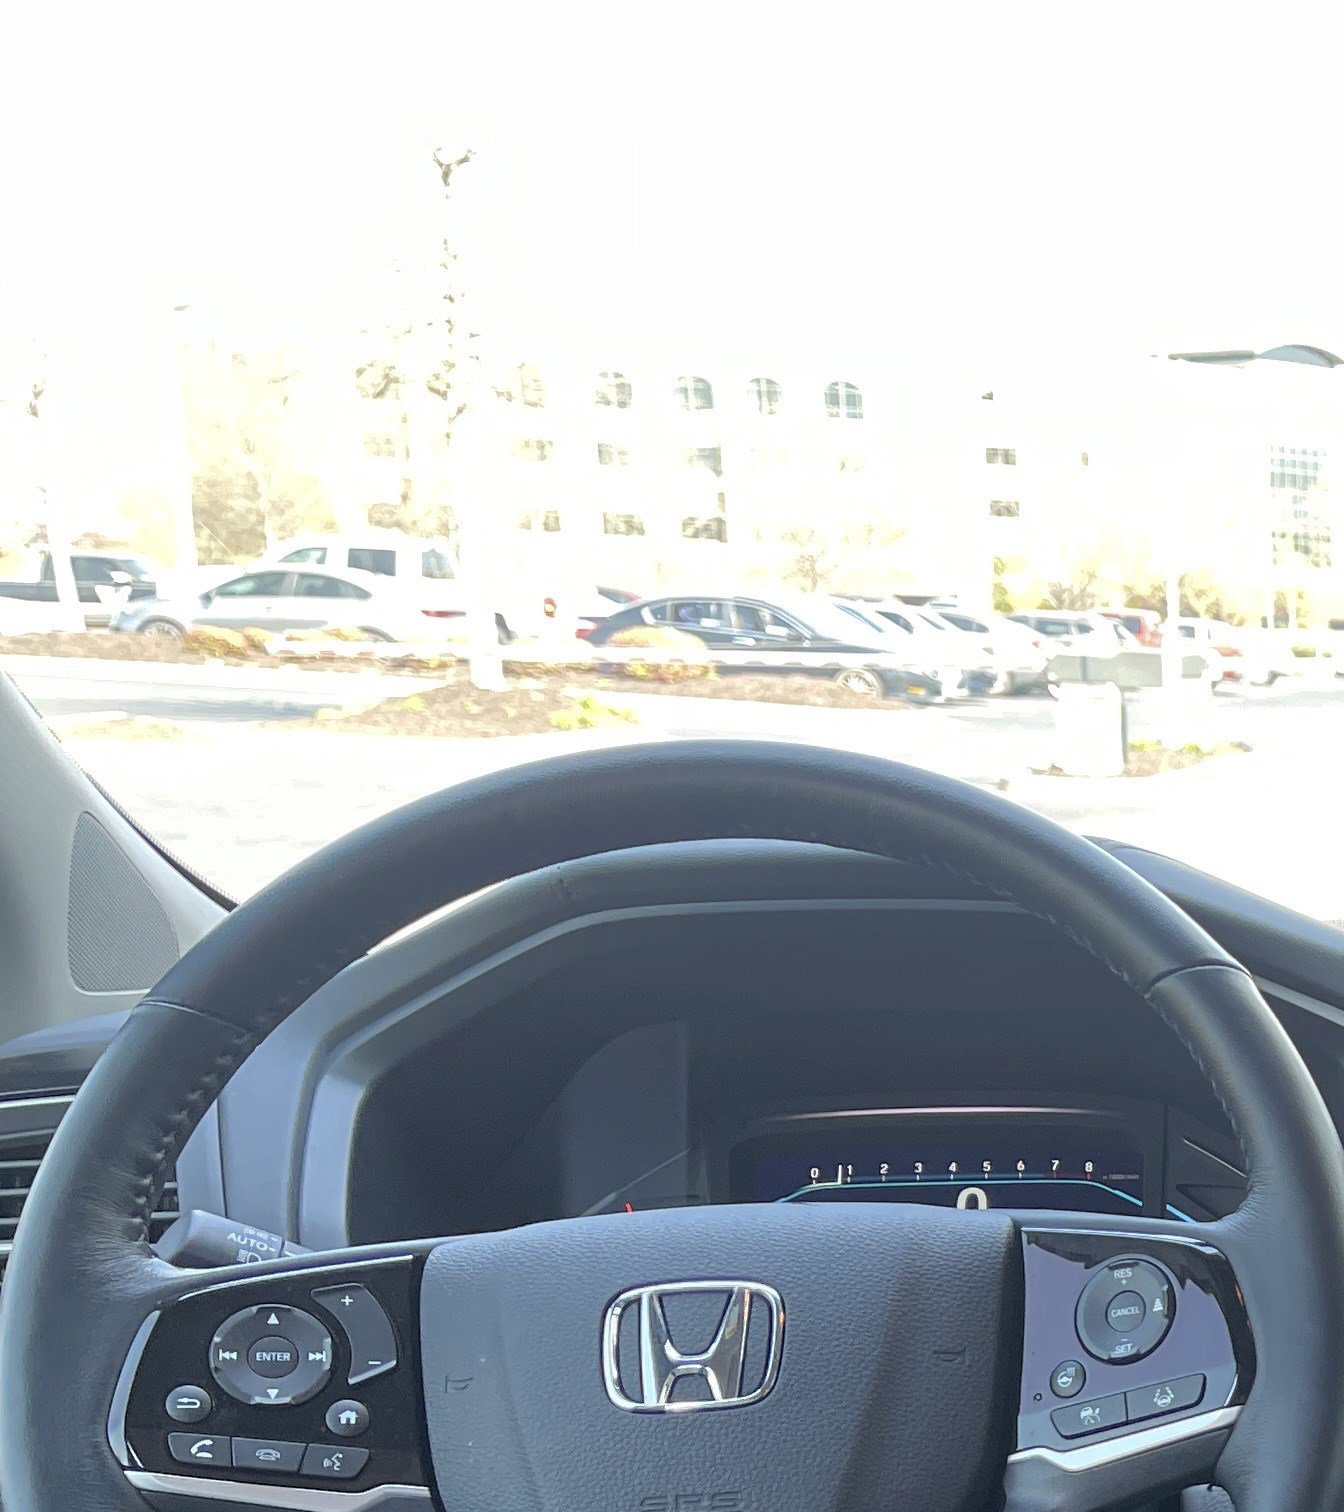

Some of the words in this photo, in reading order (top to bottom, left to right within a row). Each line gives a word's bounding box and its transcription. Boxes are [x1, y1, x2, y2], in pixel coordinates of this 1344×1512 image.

[811, 1167, 819, 1178] 0
[847, 1165, 853, 1174] 1
[880, 1163, 889, 1173] 2
[914, 1162, 922, 1173] 3
[949, 1161, 957, 1172] 4
[983, 1161, 991, 1171] 5
[1017, 1160, 1025, 1170] 6
[1051, 1160, 1059, 1170] 7
[1085, 1161, 1093, 1172] 8
[1114, 1268, 1132, 1278] RES
[1111, 1306, 1140, 1318] CANCEL
[1115, 1343, 1133, 1354] SET
[256, 1352, 290, 1361] ENTER
